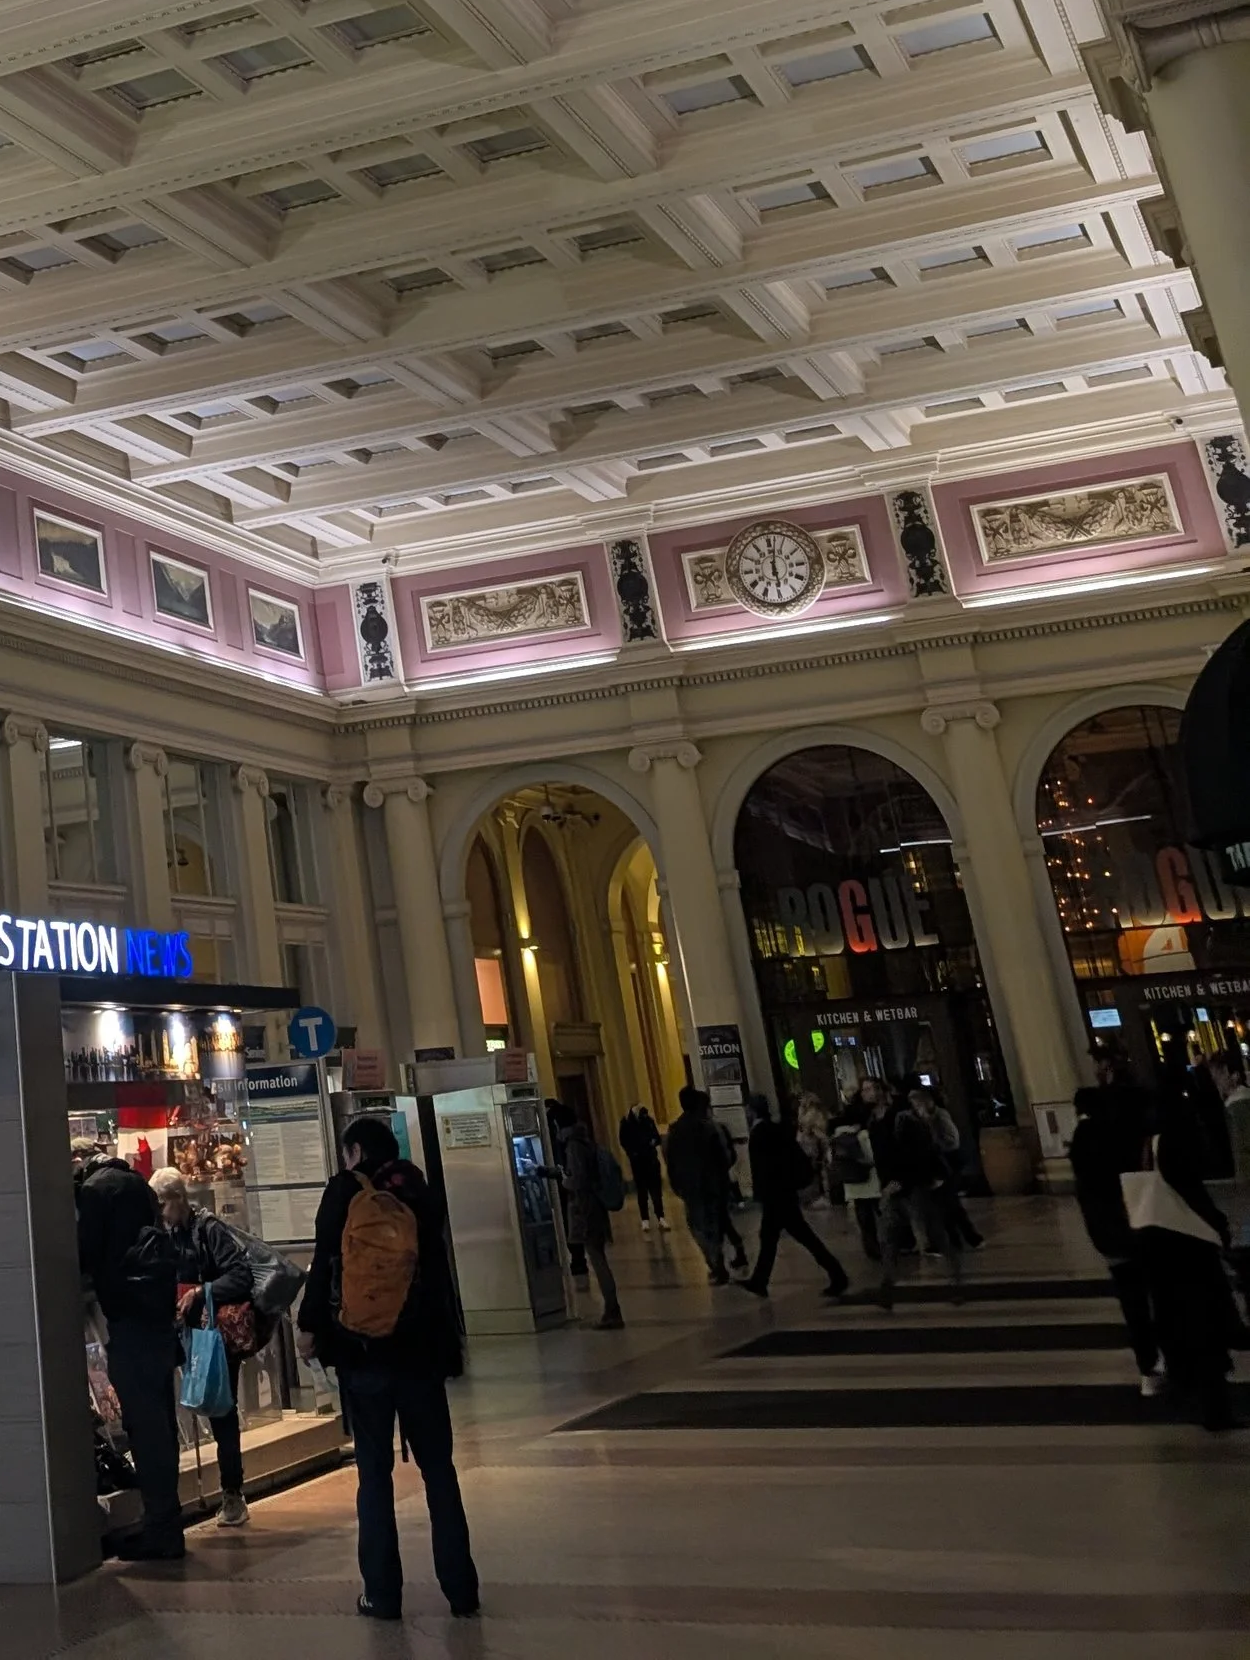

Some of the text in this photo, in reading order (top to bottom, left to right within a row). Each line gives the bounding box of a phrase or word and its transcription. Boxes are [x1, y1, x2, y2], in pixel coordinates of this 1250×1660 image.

[777, 874, 940, 957] ROGUE
[124, 927, 194, 978] NEWS
[1143, 980, 1250, 1001] KITCHEN & WETBA
[816, 1006, 919, 1027] KITCHEN & WETBAR
[298, 1016, 323, 1052] T
[698, 1043, 741, 1057] STATION
